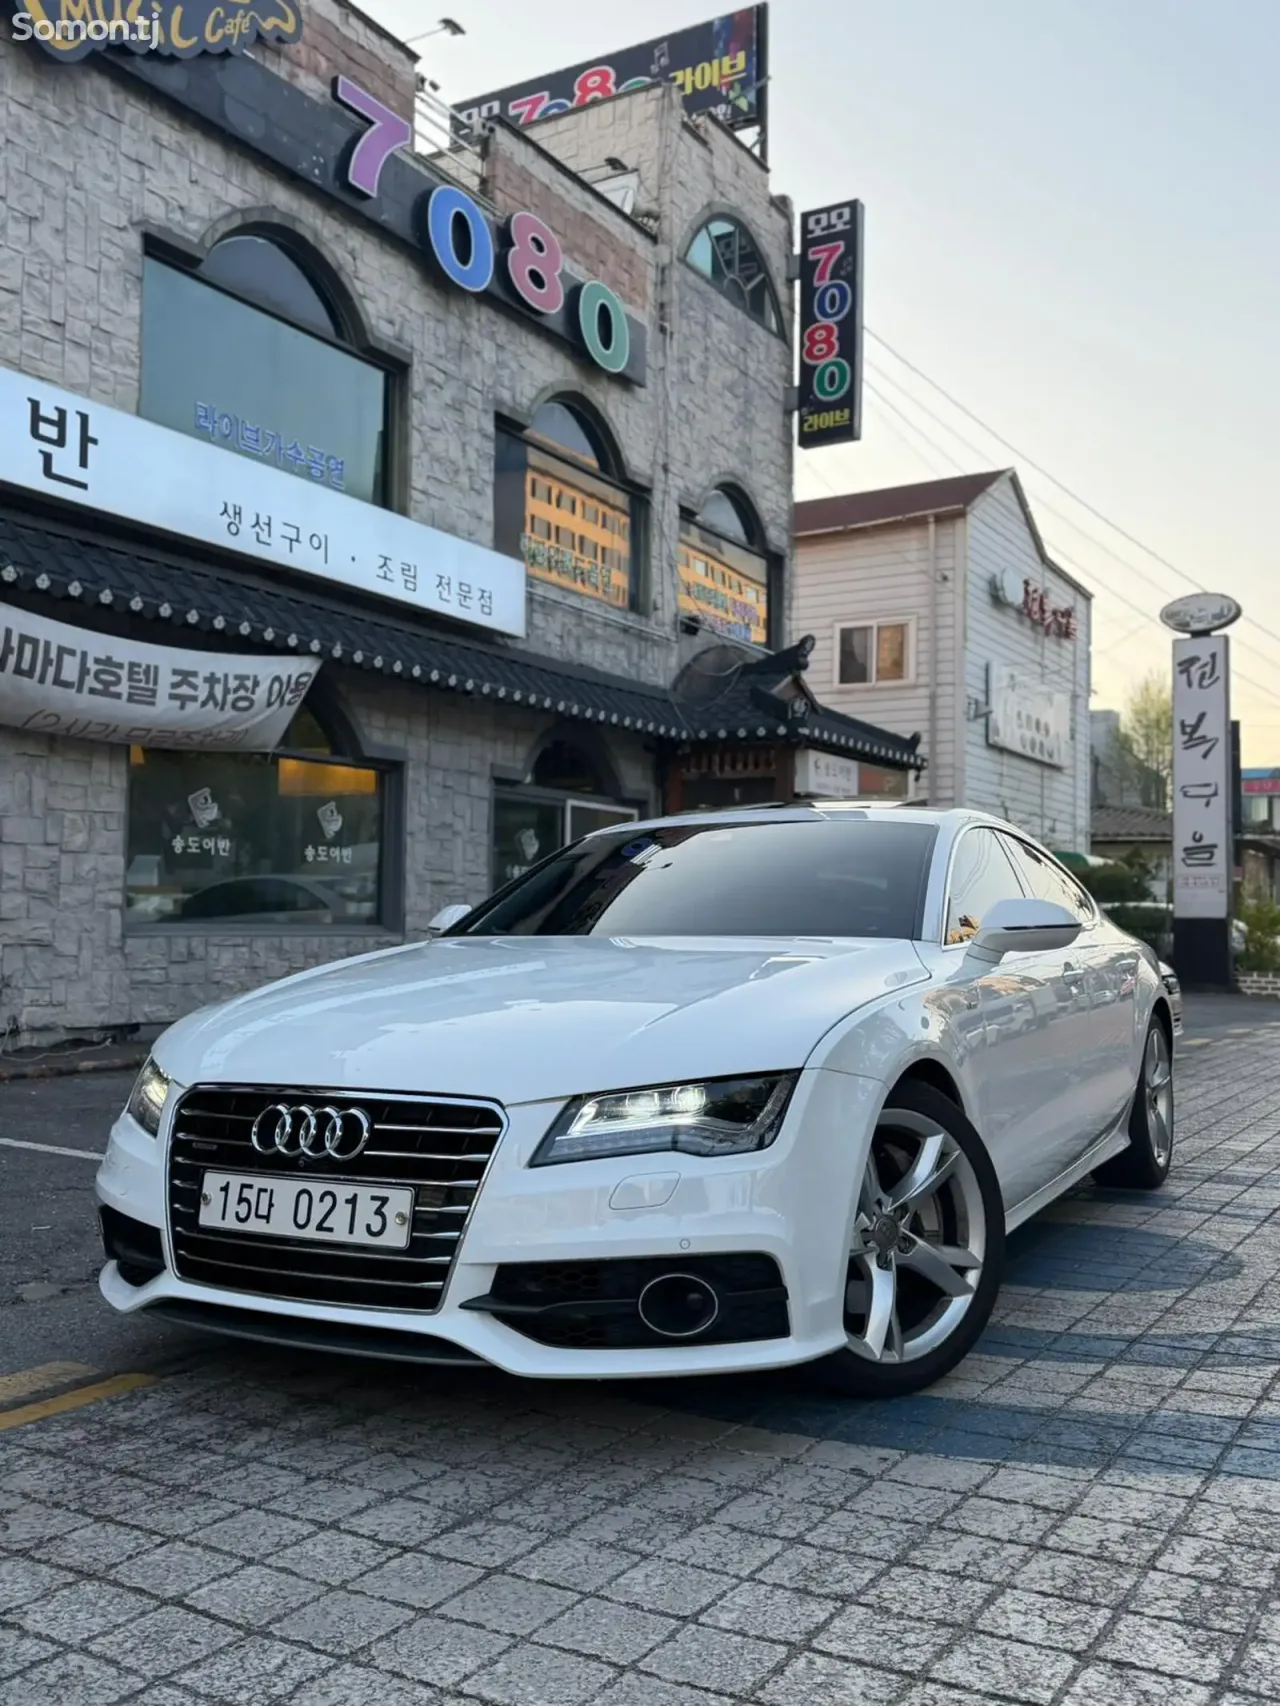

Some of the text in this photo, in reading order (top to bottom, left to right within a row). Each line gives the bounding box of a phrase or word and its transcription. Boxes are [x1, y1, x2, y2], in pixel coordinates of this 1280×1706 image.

[334, 74, 630, 373] 7080
[803, 241, 851, 401] 7080
[26, 396, 98, 491] 반
[803, 407, 850, 432] 라이브
[219, 501, 329, 564] 생선구이
[376, 554, 418, 592] 조림
[435, 573, 493, 616] 전문점
[168, 667, 260, 712] 주차장
[292, 1187, 390, 1238] 0213
